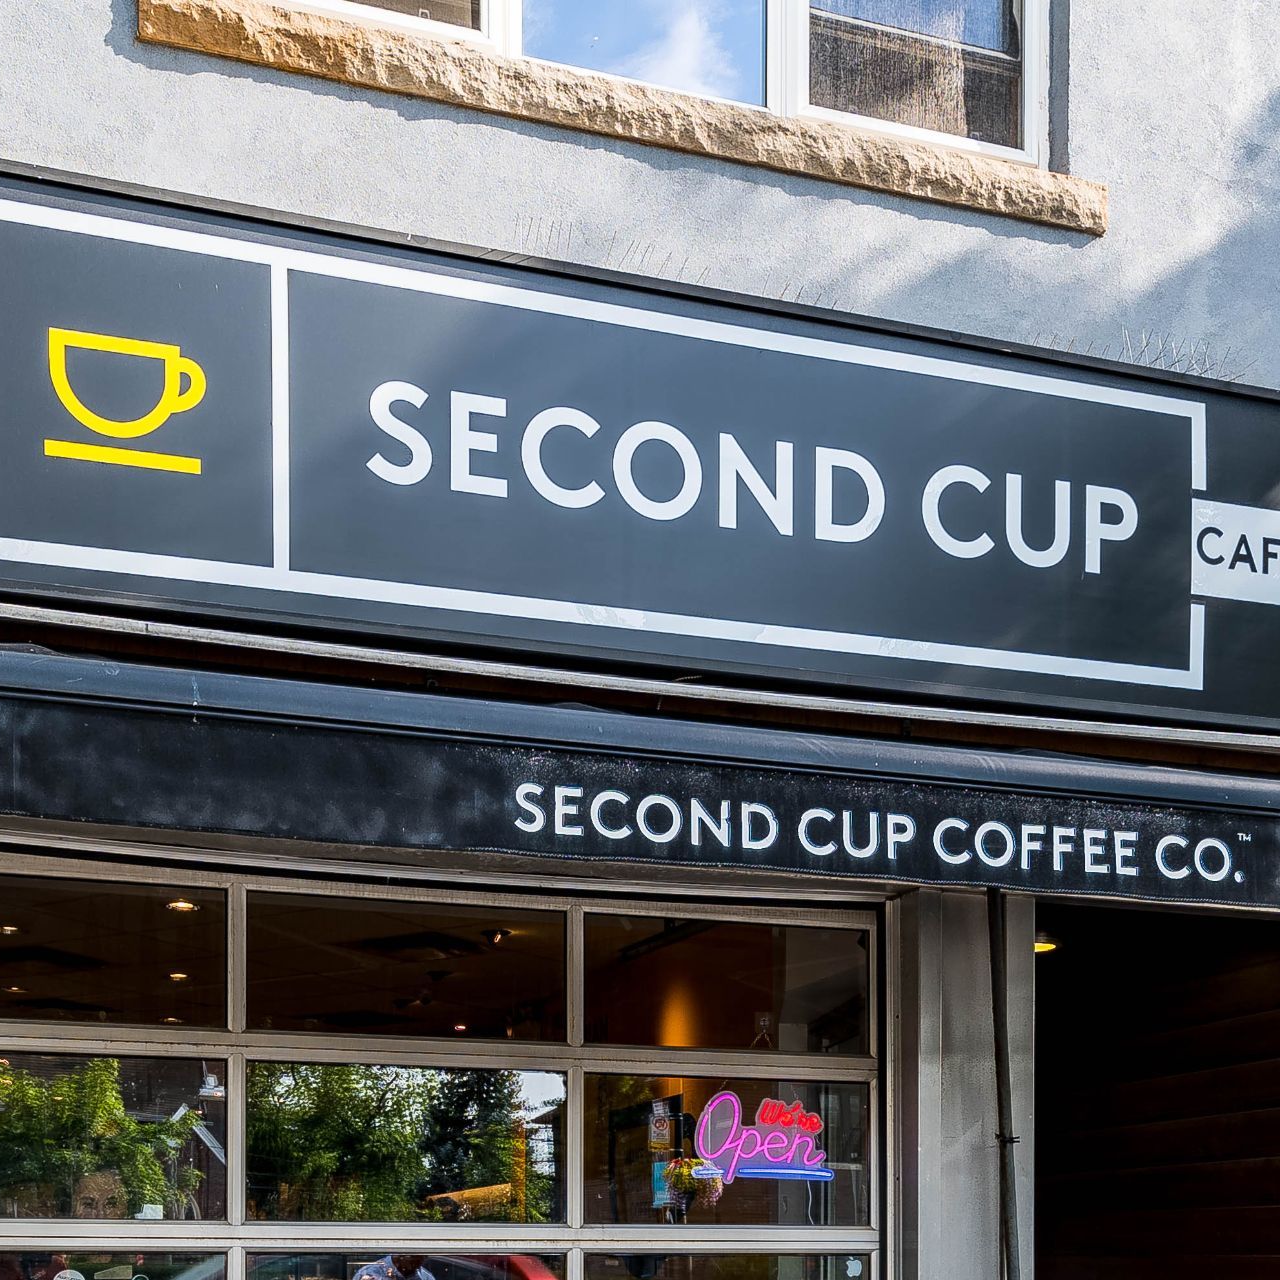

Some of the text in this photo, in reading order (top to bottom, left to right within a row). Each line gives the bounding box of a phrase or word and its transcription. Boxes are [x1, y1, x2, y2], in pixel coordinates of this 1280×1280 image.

[365, 380, 1138, 574] SECOND CUP
[514, 781, 779, 850] SECOND
[797, 808, 917, 860] CUP
[932, 817, 1140, 876] COFFEE
[697, 1092, 825, 1183] Open
